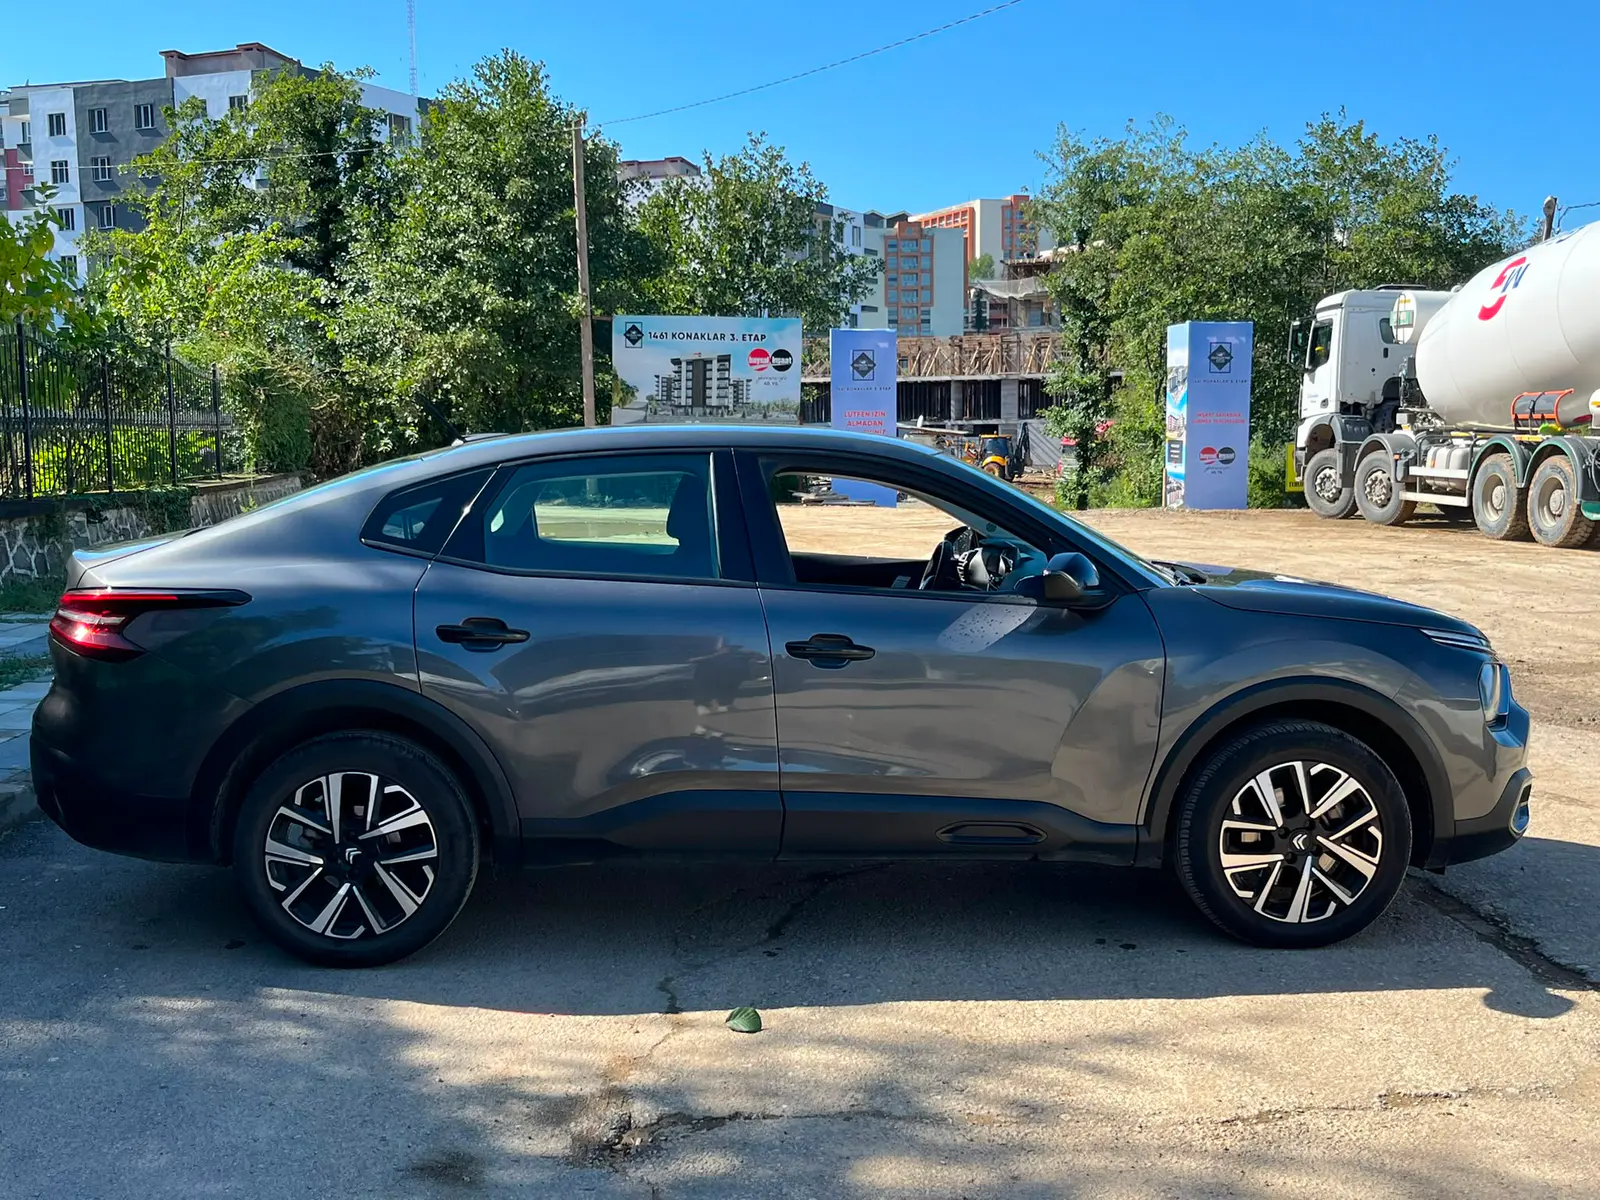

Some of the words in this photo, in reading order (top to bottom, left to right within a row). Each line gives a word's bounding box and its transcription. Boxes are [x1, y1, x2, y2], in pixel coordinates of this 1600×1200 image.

[648, 331, 668, 340] 1461
[671, 331, 726, 341] KONAKLAR
[730, 333, 739, 341] 3.
[742, 333, 767, 342] ETAP
